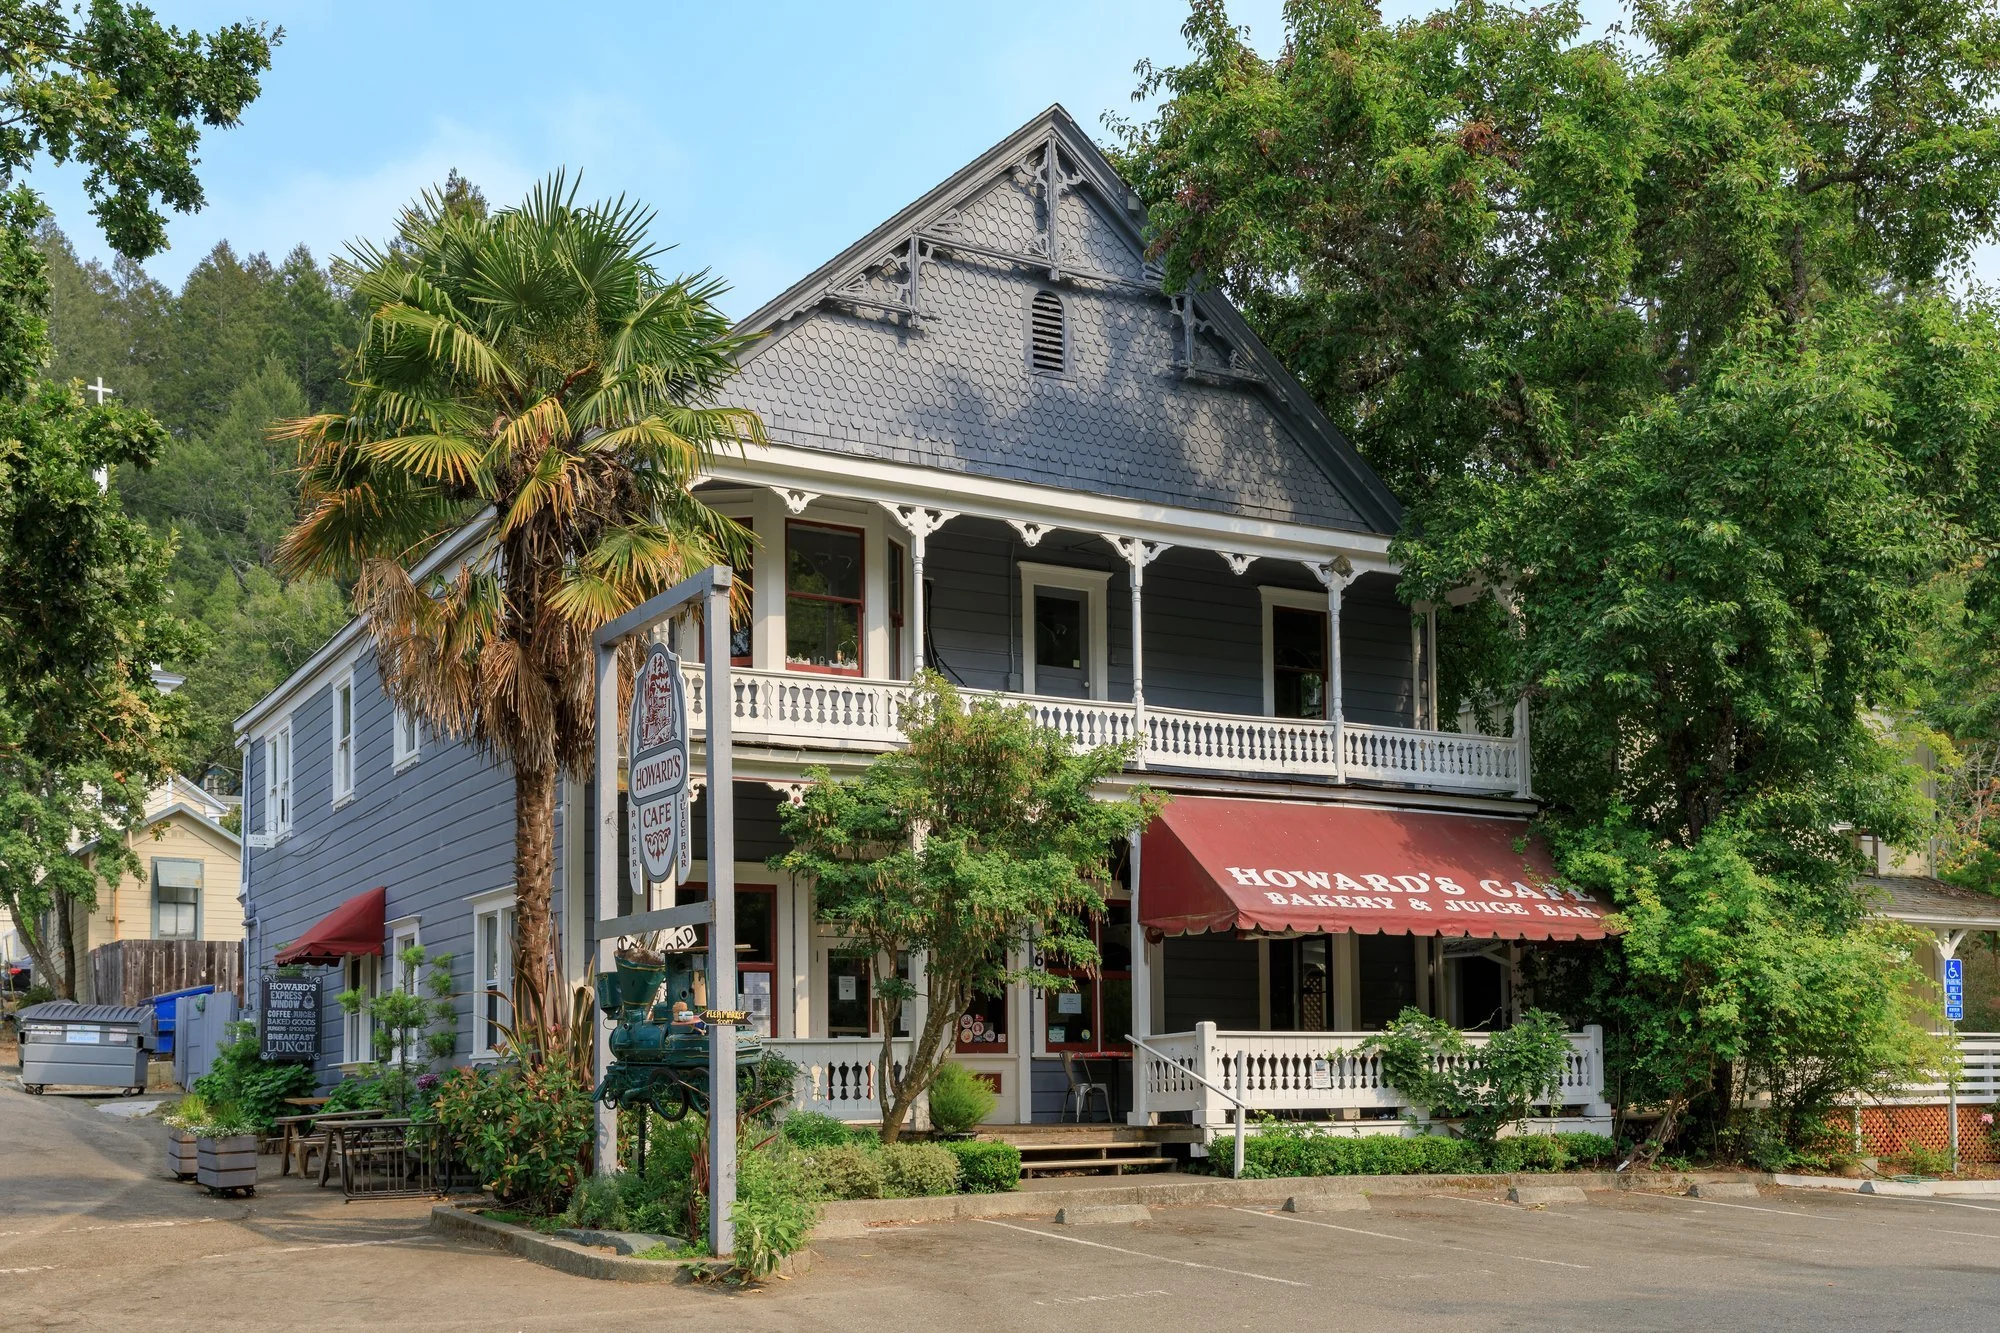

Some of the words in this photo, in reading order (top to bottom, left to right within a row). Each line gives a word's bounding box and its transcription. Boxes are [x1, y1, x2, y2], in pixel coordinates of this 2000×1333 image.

[635, 754, 681, 792] HOWARD'S
[643, 802, 671, 829] CAFE
[1224, 866, 1466, 896] HOWARD'S
[1263, 892, 1396, 910] BAKERY
[1408, 898, 1433, 912] &
[1444, 899, 1530, 916] JUICE
[1535, 903, 1601, 919] BAR
[269, 982, 317, 992] HOWARD'S
[270, 991, 303, 1000] EXPRESS
[270, 1000, 301, 1009] WINDOW
[267, 1010, 292, 1018] COFFEE
[292, 1010, 317, 1019] JUICES
[267, 1033, 316, 1041] BREAKFAST
[267, 1041, 315, 1053] LUNCH
